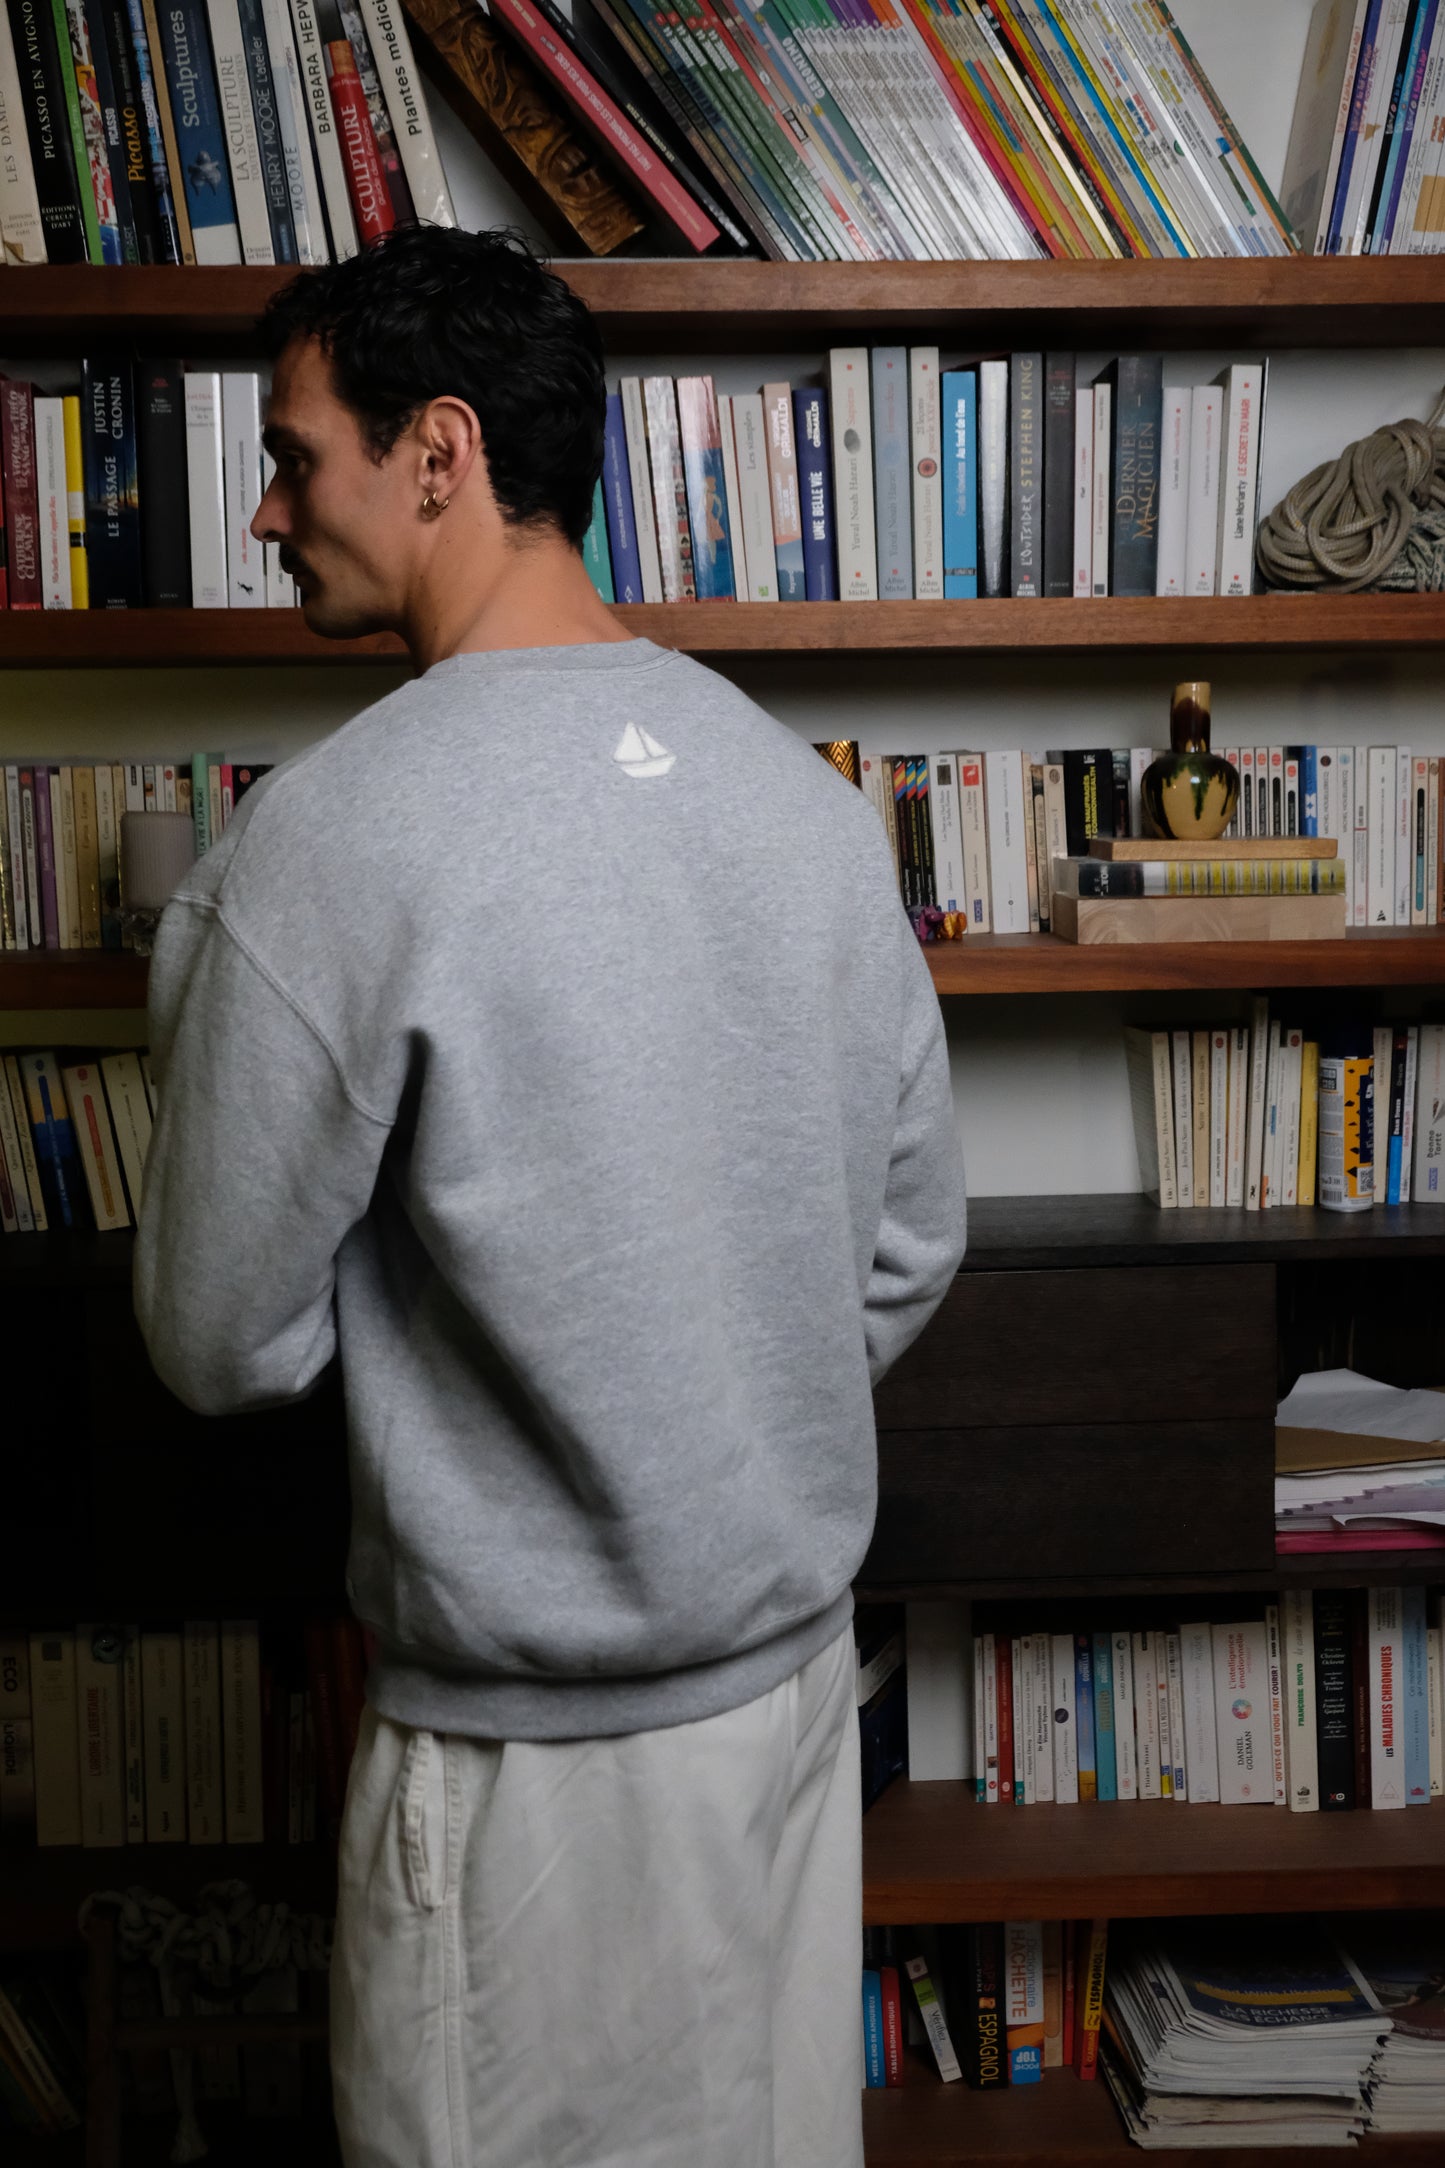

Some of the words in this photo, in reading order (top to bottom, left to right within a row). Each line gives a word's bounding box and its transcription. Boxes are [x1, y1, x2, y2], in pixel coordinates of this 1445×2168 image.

[21, 0, 40, 62] AVIGNO
[377, 0, 402, 60] médici
[33, 69, 46, 90] EN
[170, 8, 200, 128] Sculptures
[782, 36, 825, 99] GERONIMO
[219, 55, 246, 157] SCULPTURE
[307, 55, 331, 134] BARBARA
[395, 66, 422, 136] Plantes
[40, 95, 56, 160] PICASSO
[105, 107, 119, 147] PICASSO
[256, 87, 276, 145] MOORE
[127, 107, 146, 182] Picasso
[341, 103, 379, 223] SCULPTURE
[237, 161, 250, 182] LA
[267, 152, 286, 208] HENRY
[1020, 359, 1033, 401] KING
[93, 381, 109, 435] JUSTIN
[109, 376, 124, 440] CRONIN
[777, 397, 792, 458] GRIMALDI
[811, 400, 822, 448] GRIMALDI
[1240, 419, 1249, 431] DU
[1241, 398, 1251, 418] MARI
[1020, 407, 1033, 488] STEPHEN
[1238, 434, 1248, 466] SECRET
[104, 455, 119, 517] PASSAGE
[808, 471, 823, 487] VIE
[849, 457, 860, 490] Harari
[1116, 424, 1136, 520] DERNIER
[1132, 421, 1157, 538] MAGICIEN
[1238, 467, 1247, 477] LE
[810, 489, 825, 517] BELLE
[108, 522, 120, 538] LE
[812, 519, 826, 541] UNE
[1234, 516, 1244, 539] Liane
[1089, 766, 1098, 834] COMMONWEALTH
[1271, 1670, 1280, 1695] COURIR
[1380, 1645, 1392, 1701] CHRONIQUES
[1272, 1698, 1280, 1711] FAIT
[1273, 1713, 1281, 1732] VOUS
[1381, 1702, 1393, 1748] MALADIES
[1246, 1730, 1254, 1771] GOLEMAN
[1273, 1734, 1281, 1747] QUI
[1385, 1748, 1394, 1758] LES
[1273, 1749, 1283, 1782] QU'EST-CE
[1010, 1928, 1027, 2018] HACHETTE
[1089, 1952, 1104, 2011] L'ESPAGNOL
[869, 1995, 877, 2032] AMOUREUX
[888, 2000, 897, 2049] ROMANTIQUES
[932, 2009, 946, 2041] Vérifier
[1251, 2006, 1329, 2017] RICHESSE
[871, 2033, 877, 2043] EN
[978, 2013, 999, 2085] ESPAGNOL
[1016, 2050, 1037, 2063] TOP
[870, 2043, 879, 2078] WEEK-END
[889, 2049, 898, 2075] TABLES
